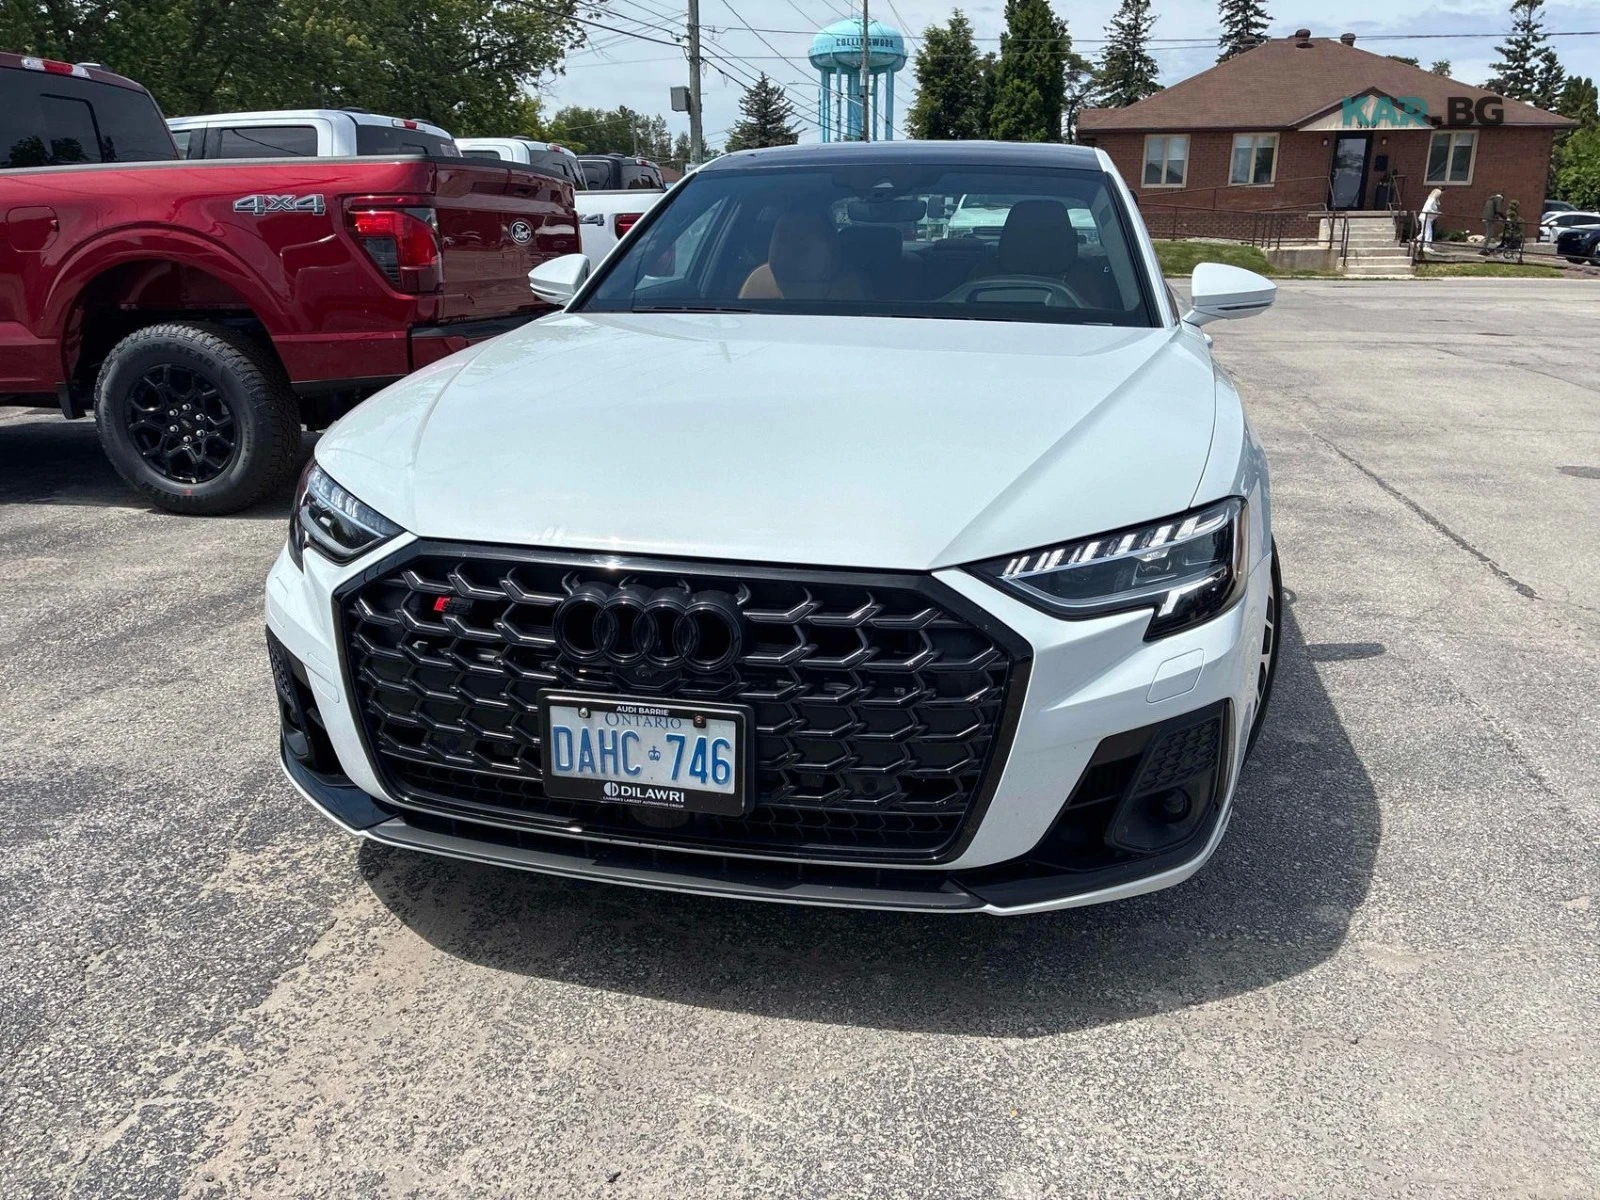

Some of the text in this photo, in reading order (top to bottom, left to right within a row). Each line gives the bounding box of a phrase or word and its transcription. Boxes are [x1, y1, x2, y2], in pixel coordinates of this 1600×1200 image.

[616, 705, 669, 717] AUDI BARRIE
[605, 711, 682, 730] ONTARIO
[552, 724, 731, 785] DAHC 746
[620, 785, 685, 803] DILAWRI
